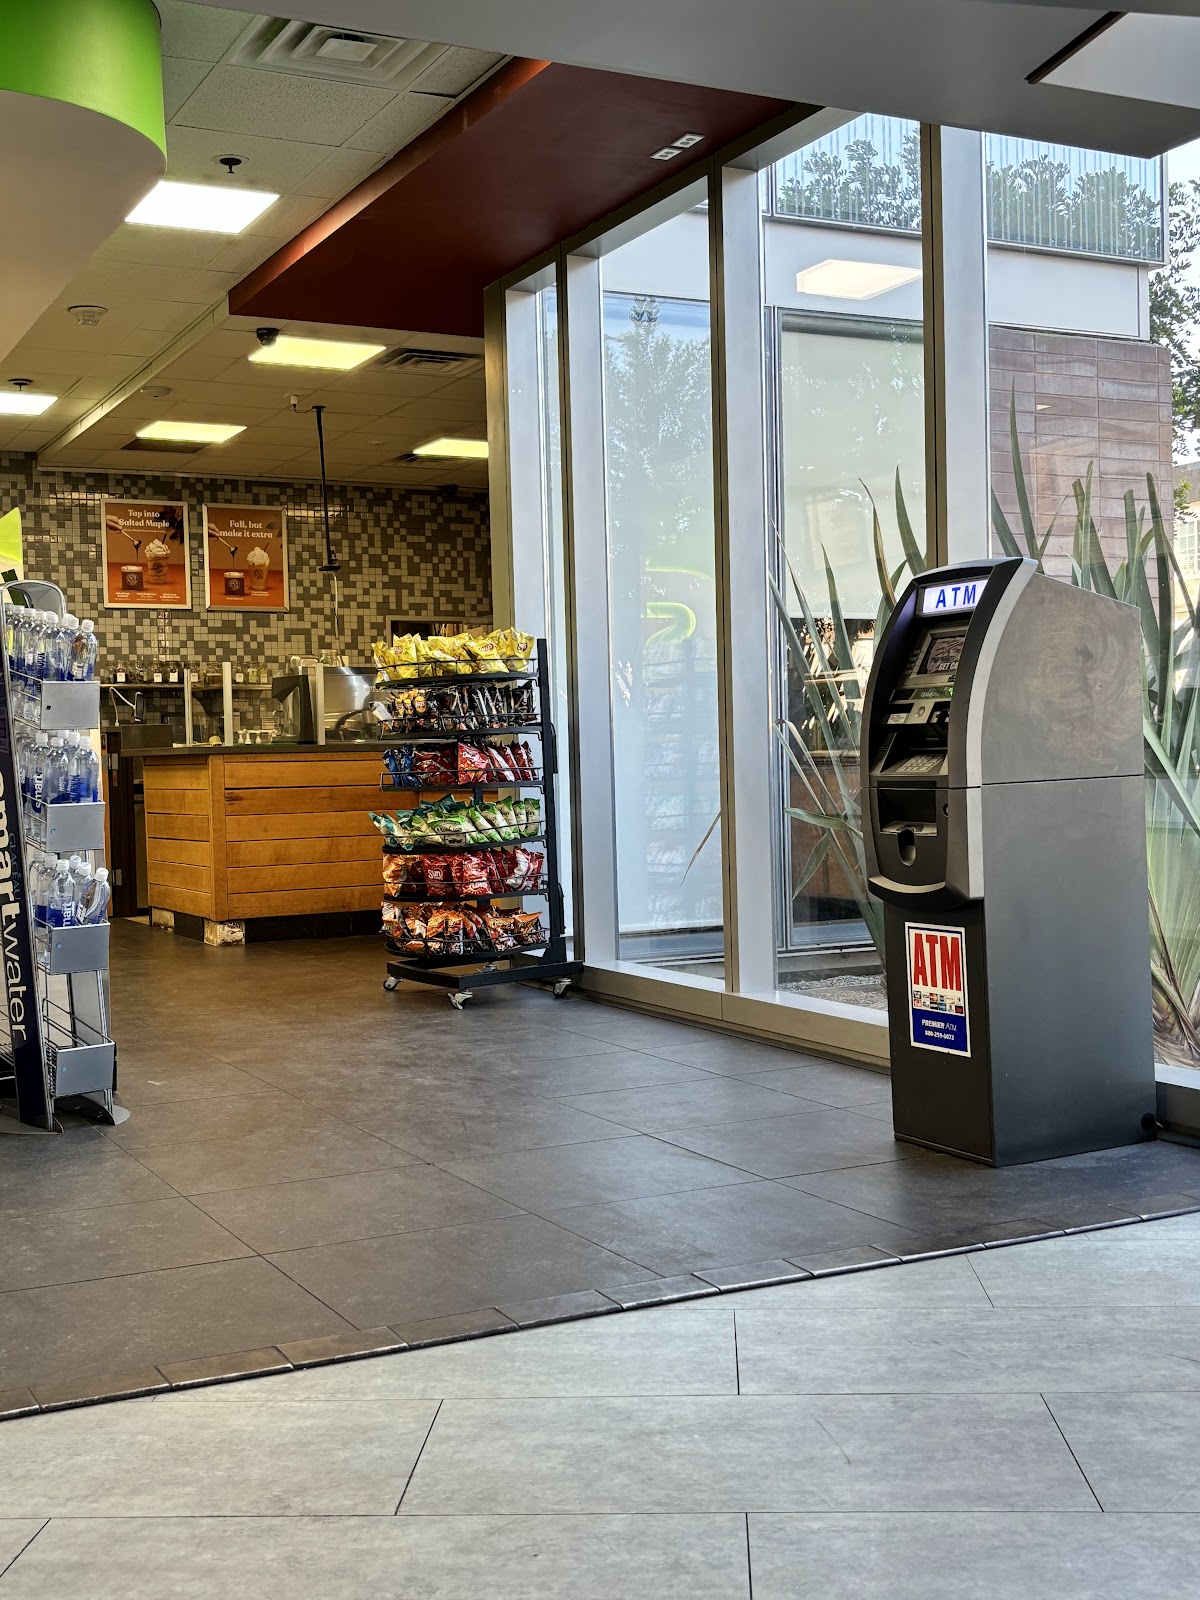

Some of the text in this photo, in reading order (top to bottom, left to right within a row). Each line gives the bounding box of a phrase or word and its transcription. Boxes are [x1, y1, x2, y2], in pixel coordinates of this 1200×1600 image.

[128, 509, 160, 518] Tap into
[118, 519, 170, 528] Salted Maple
[229, 520, 263, 529] Fall, but
[220, 529, 273, 539] make it extra
[935, 584, 977, 609] ATM
[939, 661, 959, 671] GET CA
[33, 772, 43, 809] smart
[428, 869, 442, 880] Sun
[0, 770, 27, 1041] martwater
[62, 901, 72, 927] mart
[914, 933, 961, 991] ATM
